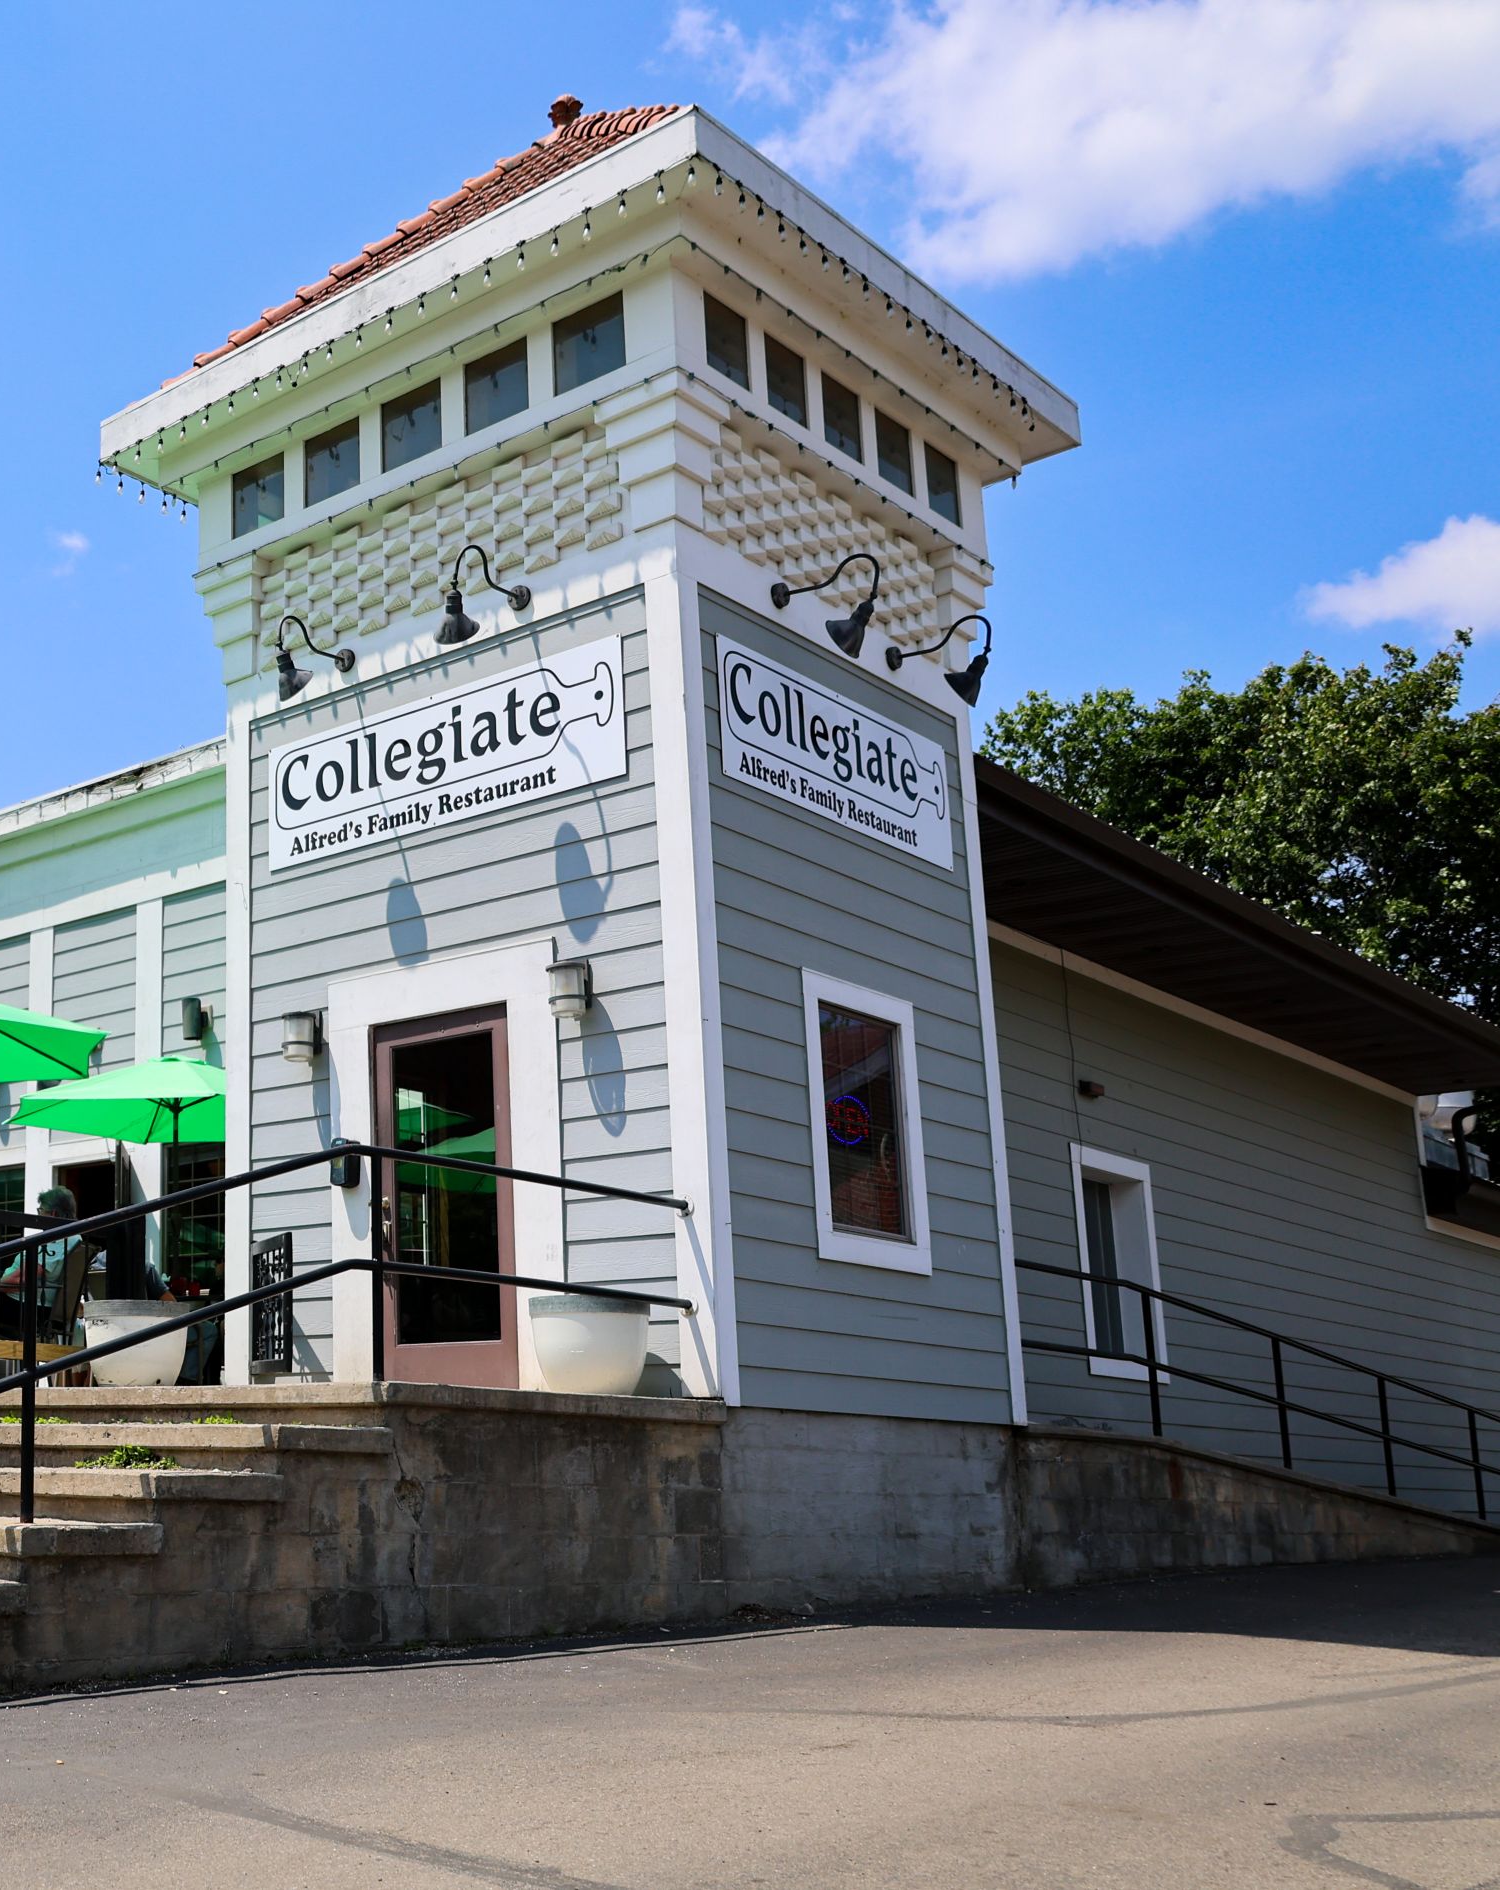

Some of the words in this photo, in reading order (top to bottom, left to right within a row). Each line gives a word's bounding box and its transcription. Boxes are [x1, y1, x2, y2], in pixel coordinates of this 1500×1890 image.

[281, 687, 561, 810] Collegiate
[730, 662, 919, 801] Collegiate
[289, 820, 362, 857] Alfred's
[367, 799, 433, 835] Family
[438, 764, 557, 815] Restaurant
[739, 751, 797, 794] Alfred's
[799, 776, 844, 818] Family
[847, 797, 918, 848] Restaurant
